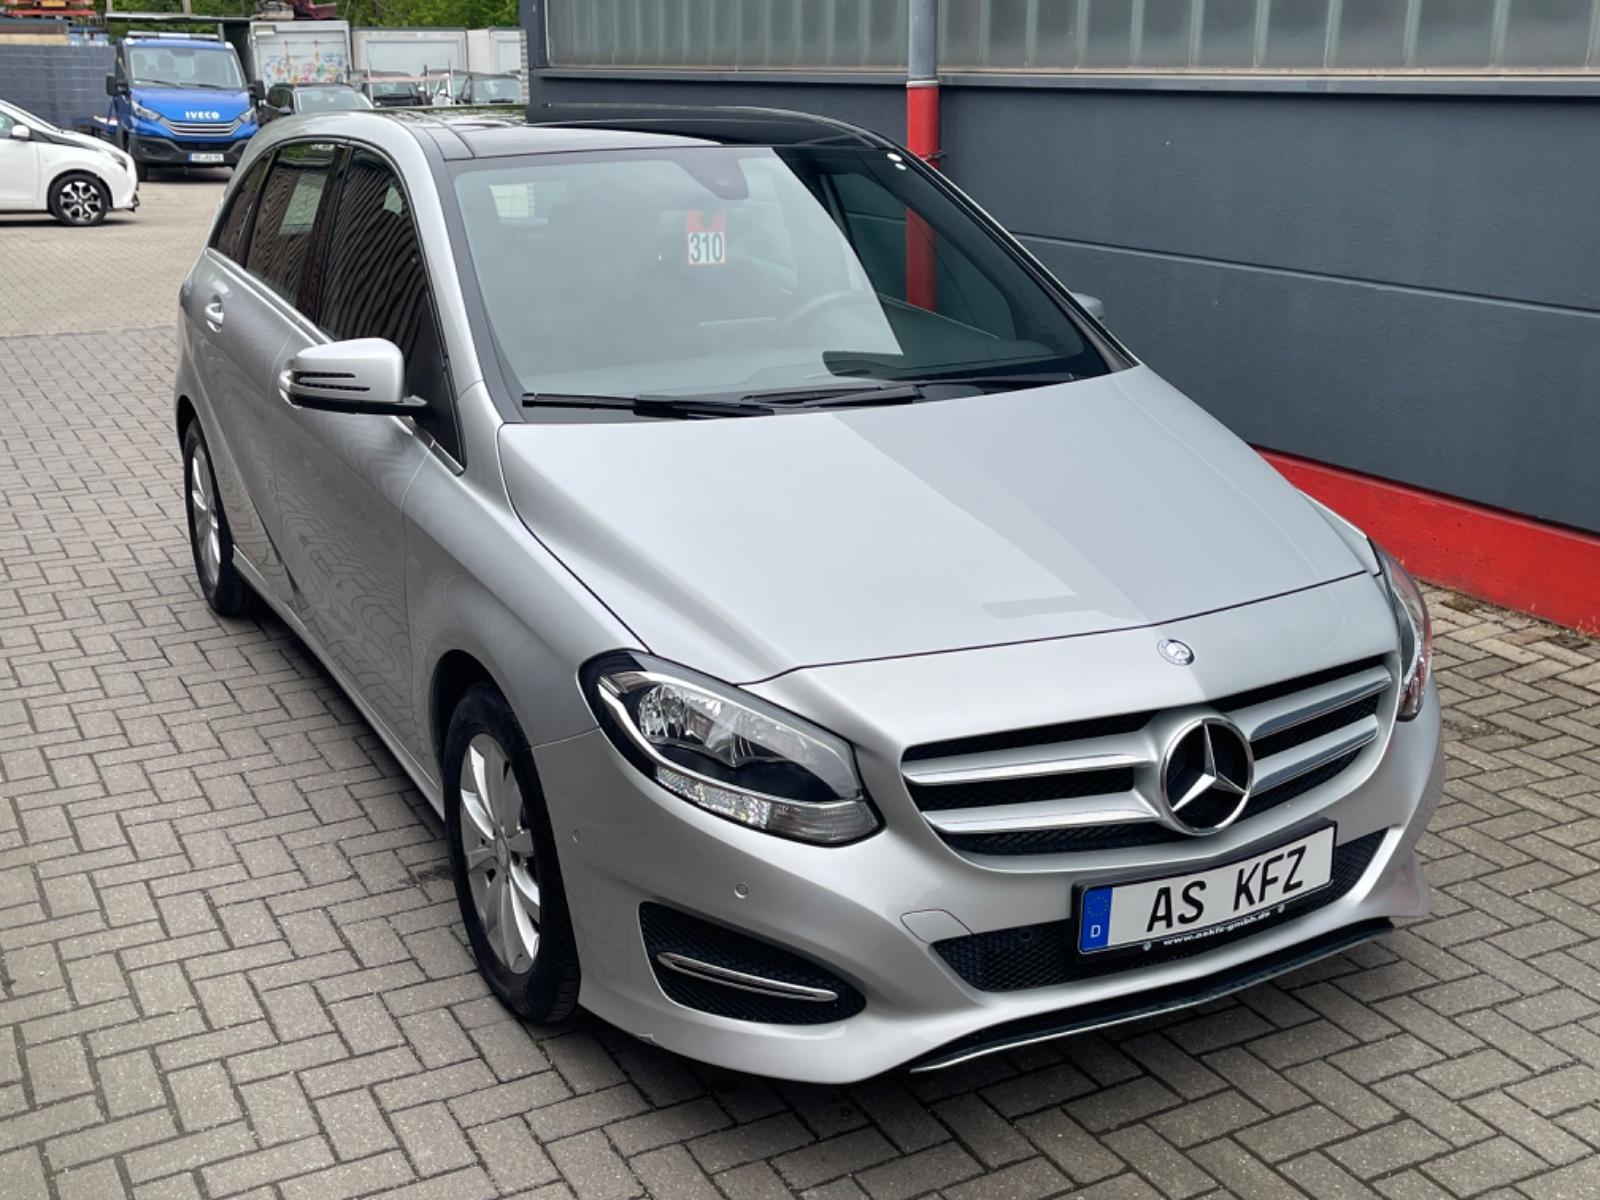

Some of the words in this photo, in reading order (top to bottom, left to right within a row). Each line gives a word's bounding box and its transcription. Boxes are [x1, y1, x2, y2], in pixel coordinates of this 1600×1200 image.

[185, 111, 220, 120] IVECO
[689, 232, 723, 262] 310
[1090, 924, 1101, 938] D
[1146, 880, 1207, 932] AS
[1233, 845, 1307, 911] KFZ
